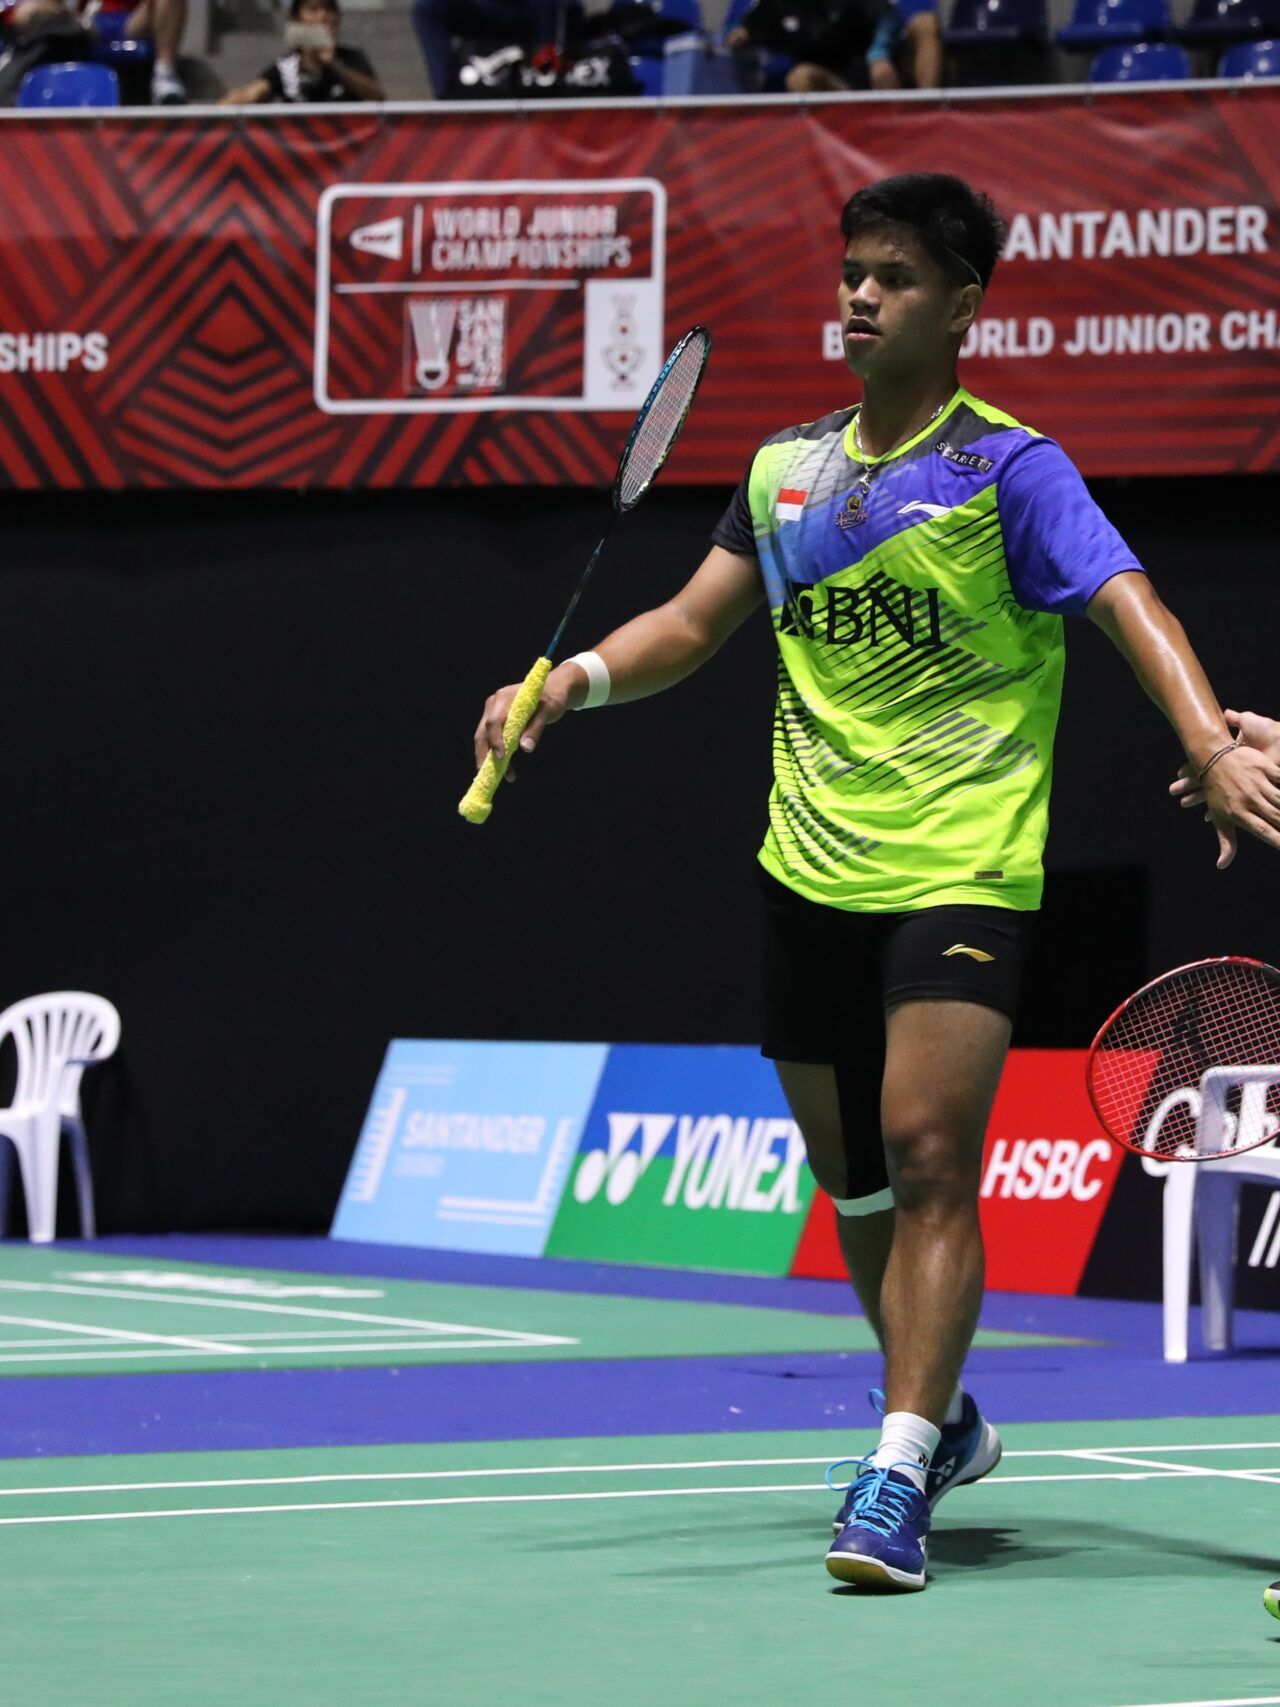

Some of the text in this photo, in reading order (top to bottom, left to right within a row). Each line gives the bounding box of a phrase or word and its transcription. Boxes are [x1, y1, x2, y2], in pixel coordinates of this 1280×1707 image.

[432, 204, 618, 239] WORLD JUNIOR
[1001, 205, 1268, 262] ANTANDER
[431, 236, 632, 271] CHAMPIONSHIPS
[0, 332, 108, 372] SHIPS
[957, 317, 1055, 359] ORLD
[1064, 312, 1211, 357] JUNIOR
[825, 584, 944, 648] BNI
[663, 1113, 807, 1214] YONEX
[980, 1138, 1112, 1202] HSBC
